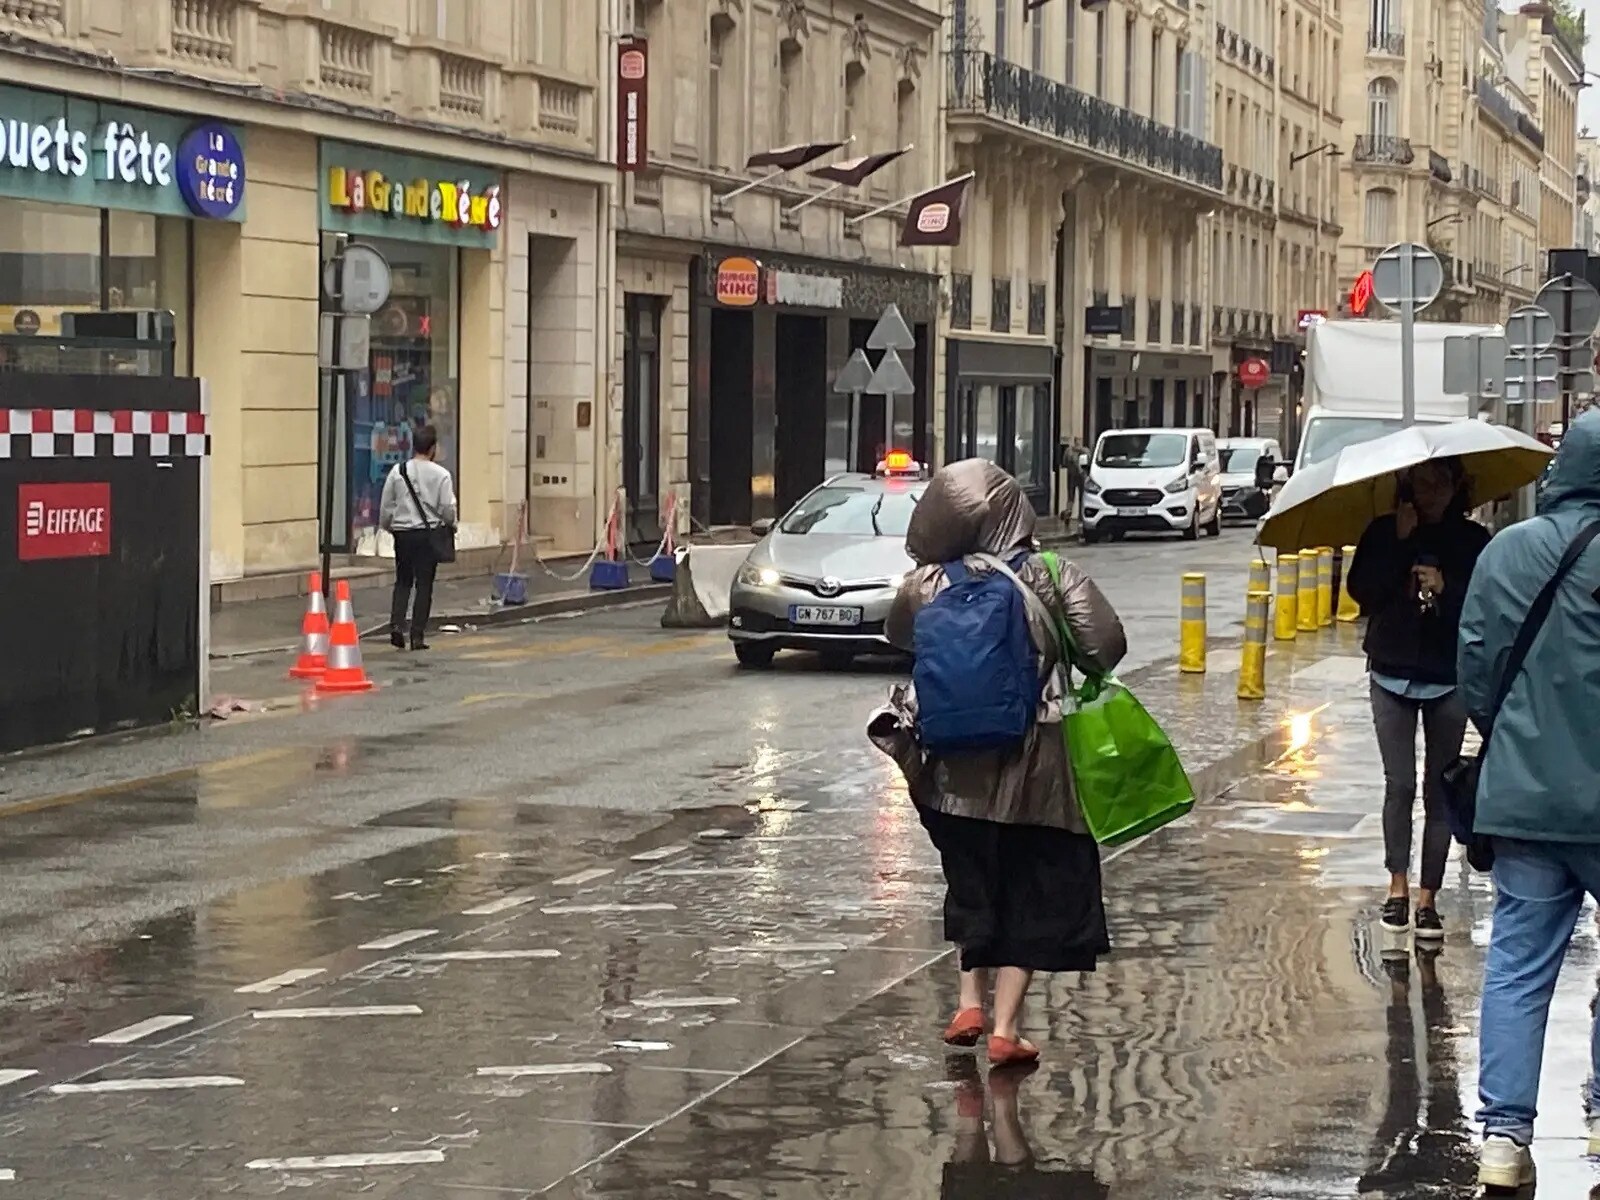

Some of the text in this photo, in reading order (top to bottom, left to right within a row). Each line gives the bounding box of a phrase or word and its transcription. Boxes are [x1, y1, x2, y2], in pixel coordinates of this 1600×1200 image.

[209, 131, 224, 151] La
[105, 120, 171, 186] fête
[718, 282, 757, 296] KING
[46, 508, 105, 535] EIFFAGE
